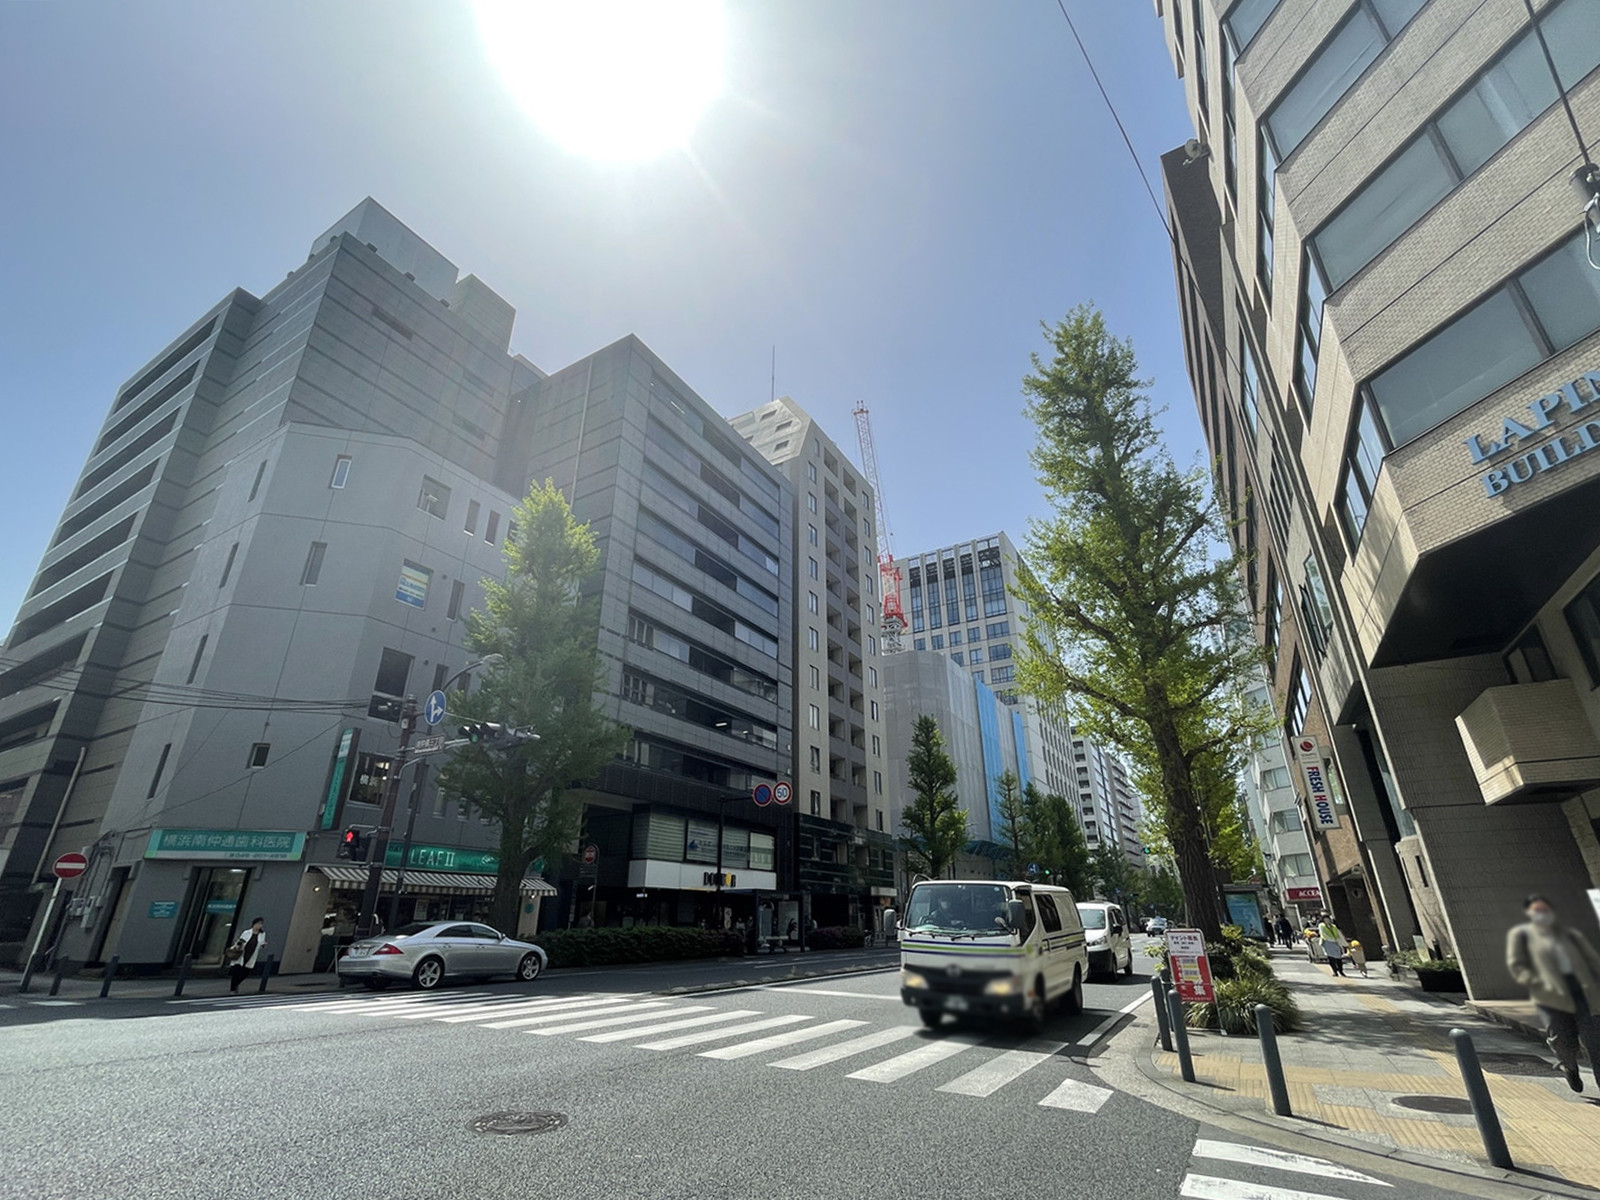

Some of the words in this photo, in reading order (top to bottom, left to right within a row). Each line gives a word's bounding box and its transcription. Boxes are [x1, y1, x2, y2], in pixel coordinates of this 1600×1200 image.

[1306, 766, 1325, 793] FRESH
[777, 787, 787, 798] 50
[1314, 795, 1333, 825] HOUSE
[163, 833, 292, 849] 横浜南仲通歯科医院
